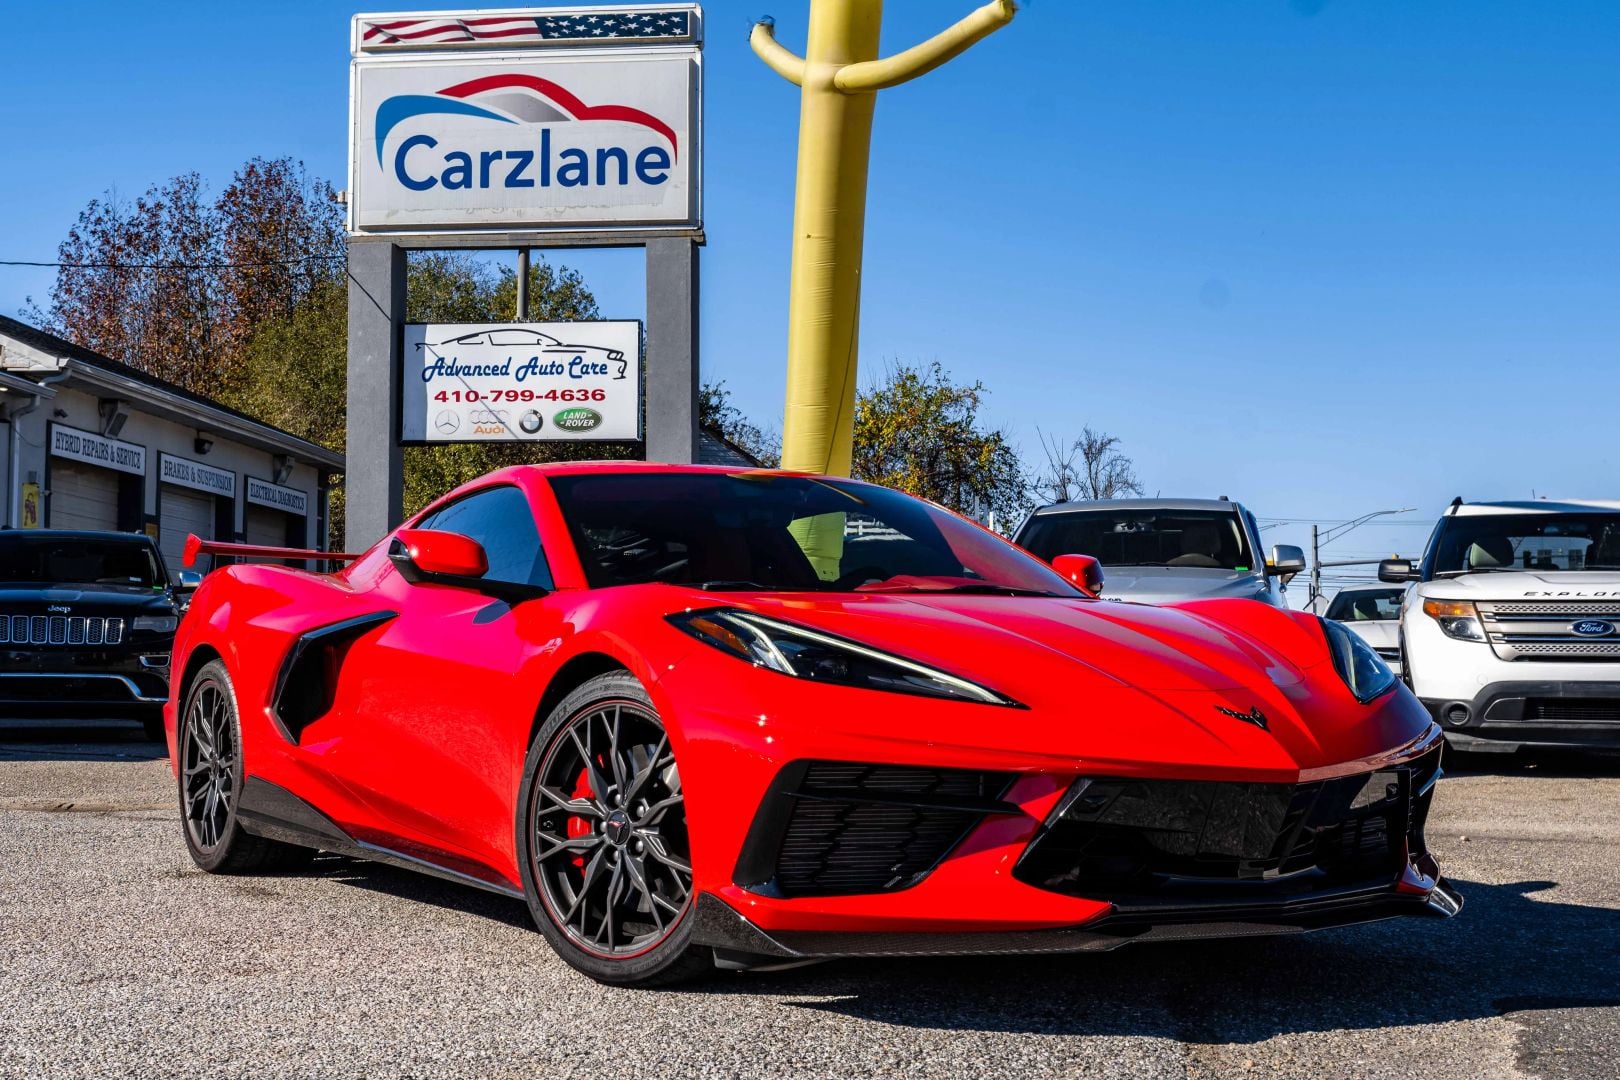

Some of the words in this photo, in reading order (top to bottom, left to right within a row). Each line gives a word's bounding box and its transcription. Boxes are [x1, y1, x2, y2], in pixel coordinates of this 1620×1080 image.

[394, 128, 671, 191] Carzlane
[421, 356, 511, 382] Advanced
[515, 356, 564, 382] Auto
[567, 355, 608, 379] Care
[433, 388, 606, 403] 410-799-4636
[473, 426, 505, 435] Audi
[55, 431, 80, 454] HYBRID
[82, 438, 109, 460] REPAIRS
[110, 445, 115, 463] &
[116, 447, 141, 469] SERVICE
[164, 460, 189, 481] BRAKES
[190, 466, 196, 483] &
[196, 468, 232, 491] SUSPENSION
[250, 483, 277, 503] ELECTRICAL
[278, 491, 304, 511] DIAGNOSTICS
[47, 604, 71, 614] Jeep
[1579, 622, 1604, 632] Ford
